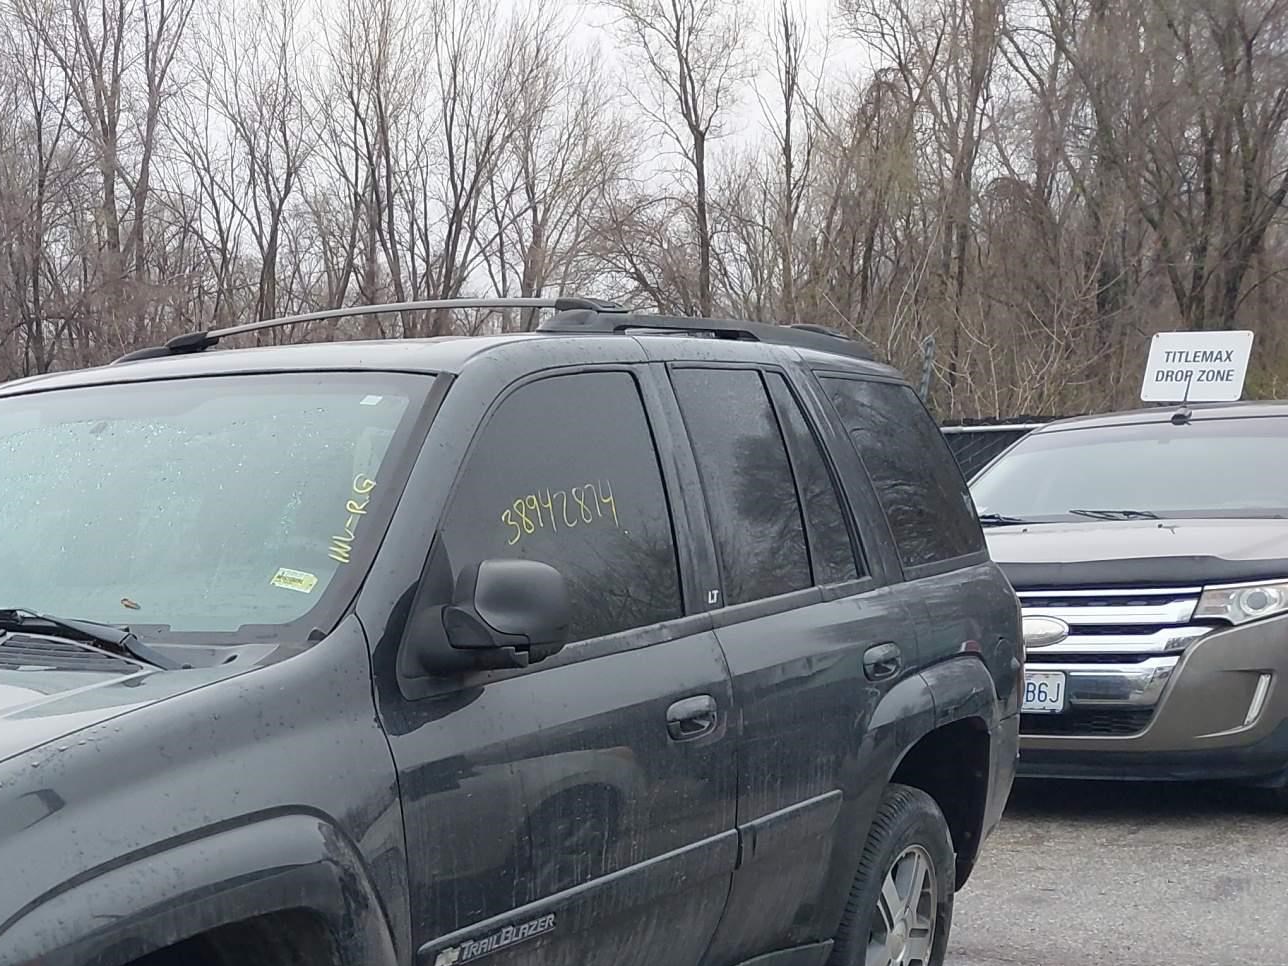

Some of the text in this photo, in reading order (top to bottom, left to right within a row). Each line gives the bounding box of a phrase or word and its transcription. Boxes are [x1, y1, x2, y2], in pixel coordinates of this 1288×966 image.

[1164, 350, 1234, 363] TITLEMAX
[1197, 369, 1235, 382] ZONE
[502, 480, 619, 545] 38942874
[708, 589, 718, 604] LT
